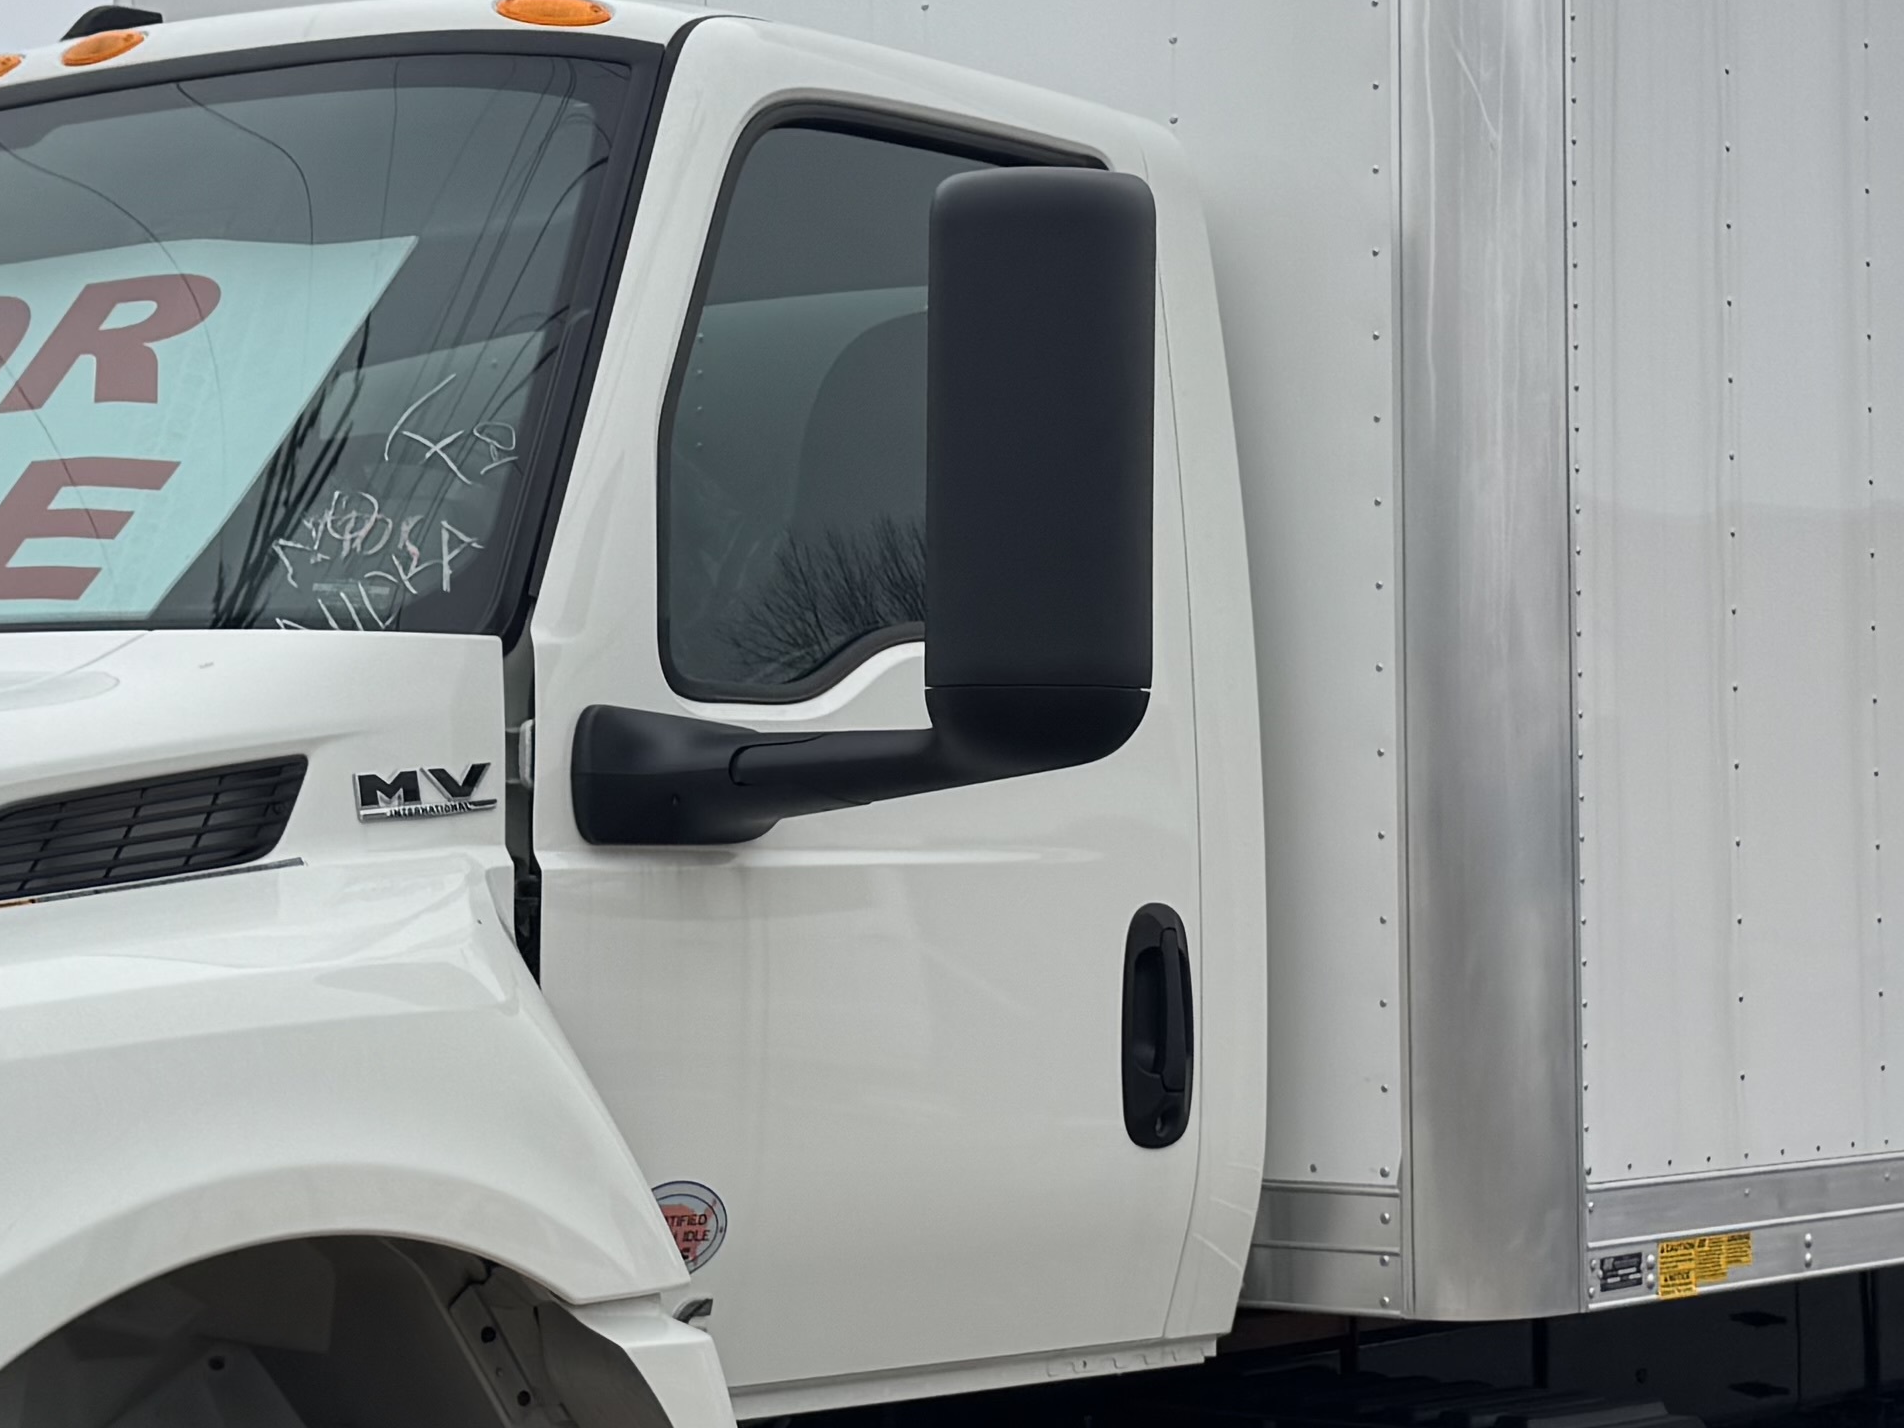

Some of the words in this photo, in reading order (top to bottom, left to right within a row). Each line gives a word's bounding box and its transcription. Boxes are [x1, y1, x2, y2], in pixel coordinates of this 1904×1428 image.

[352, 762, 492, 808] MV
[665, 1212, 708, 1228] TIFIED
[682, 1229, 711, 1242] IDLE
